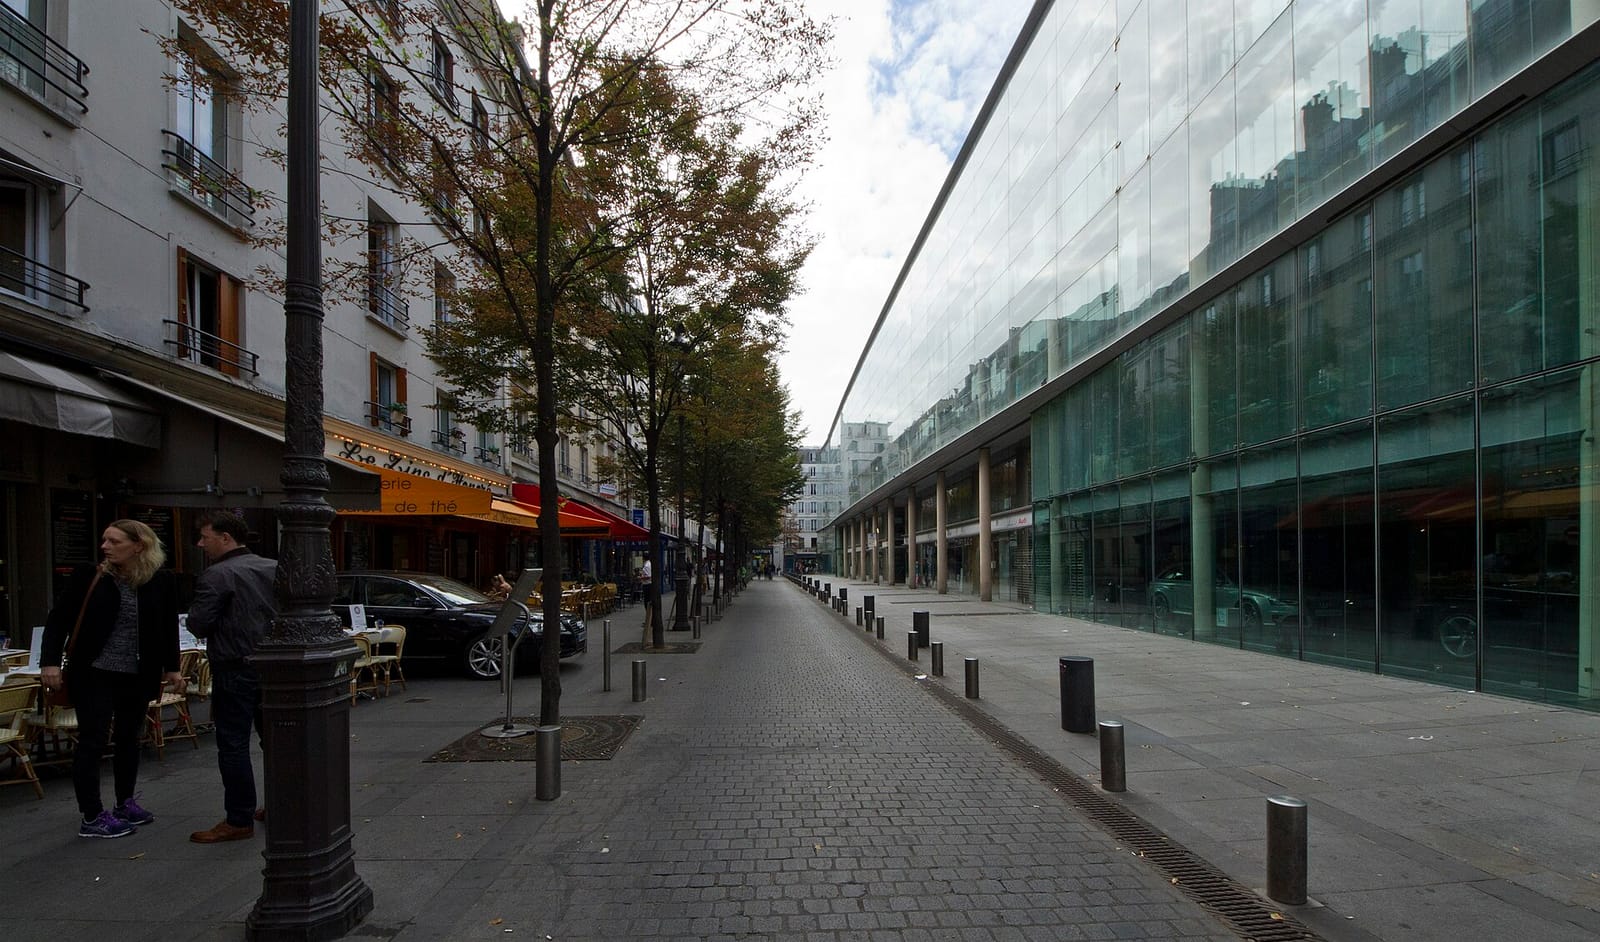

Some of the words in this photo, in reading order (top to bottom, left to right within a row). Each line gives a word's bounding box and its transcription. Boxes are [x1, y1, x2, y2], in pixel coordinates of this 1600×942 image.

[339, 441, 377, 464] Le
[394, 500, 418, 513] de
[430, 499, 457, 513] thé
